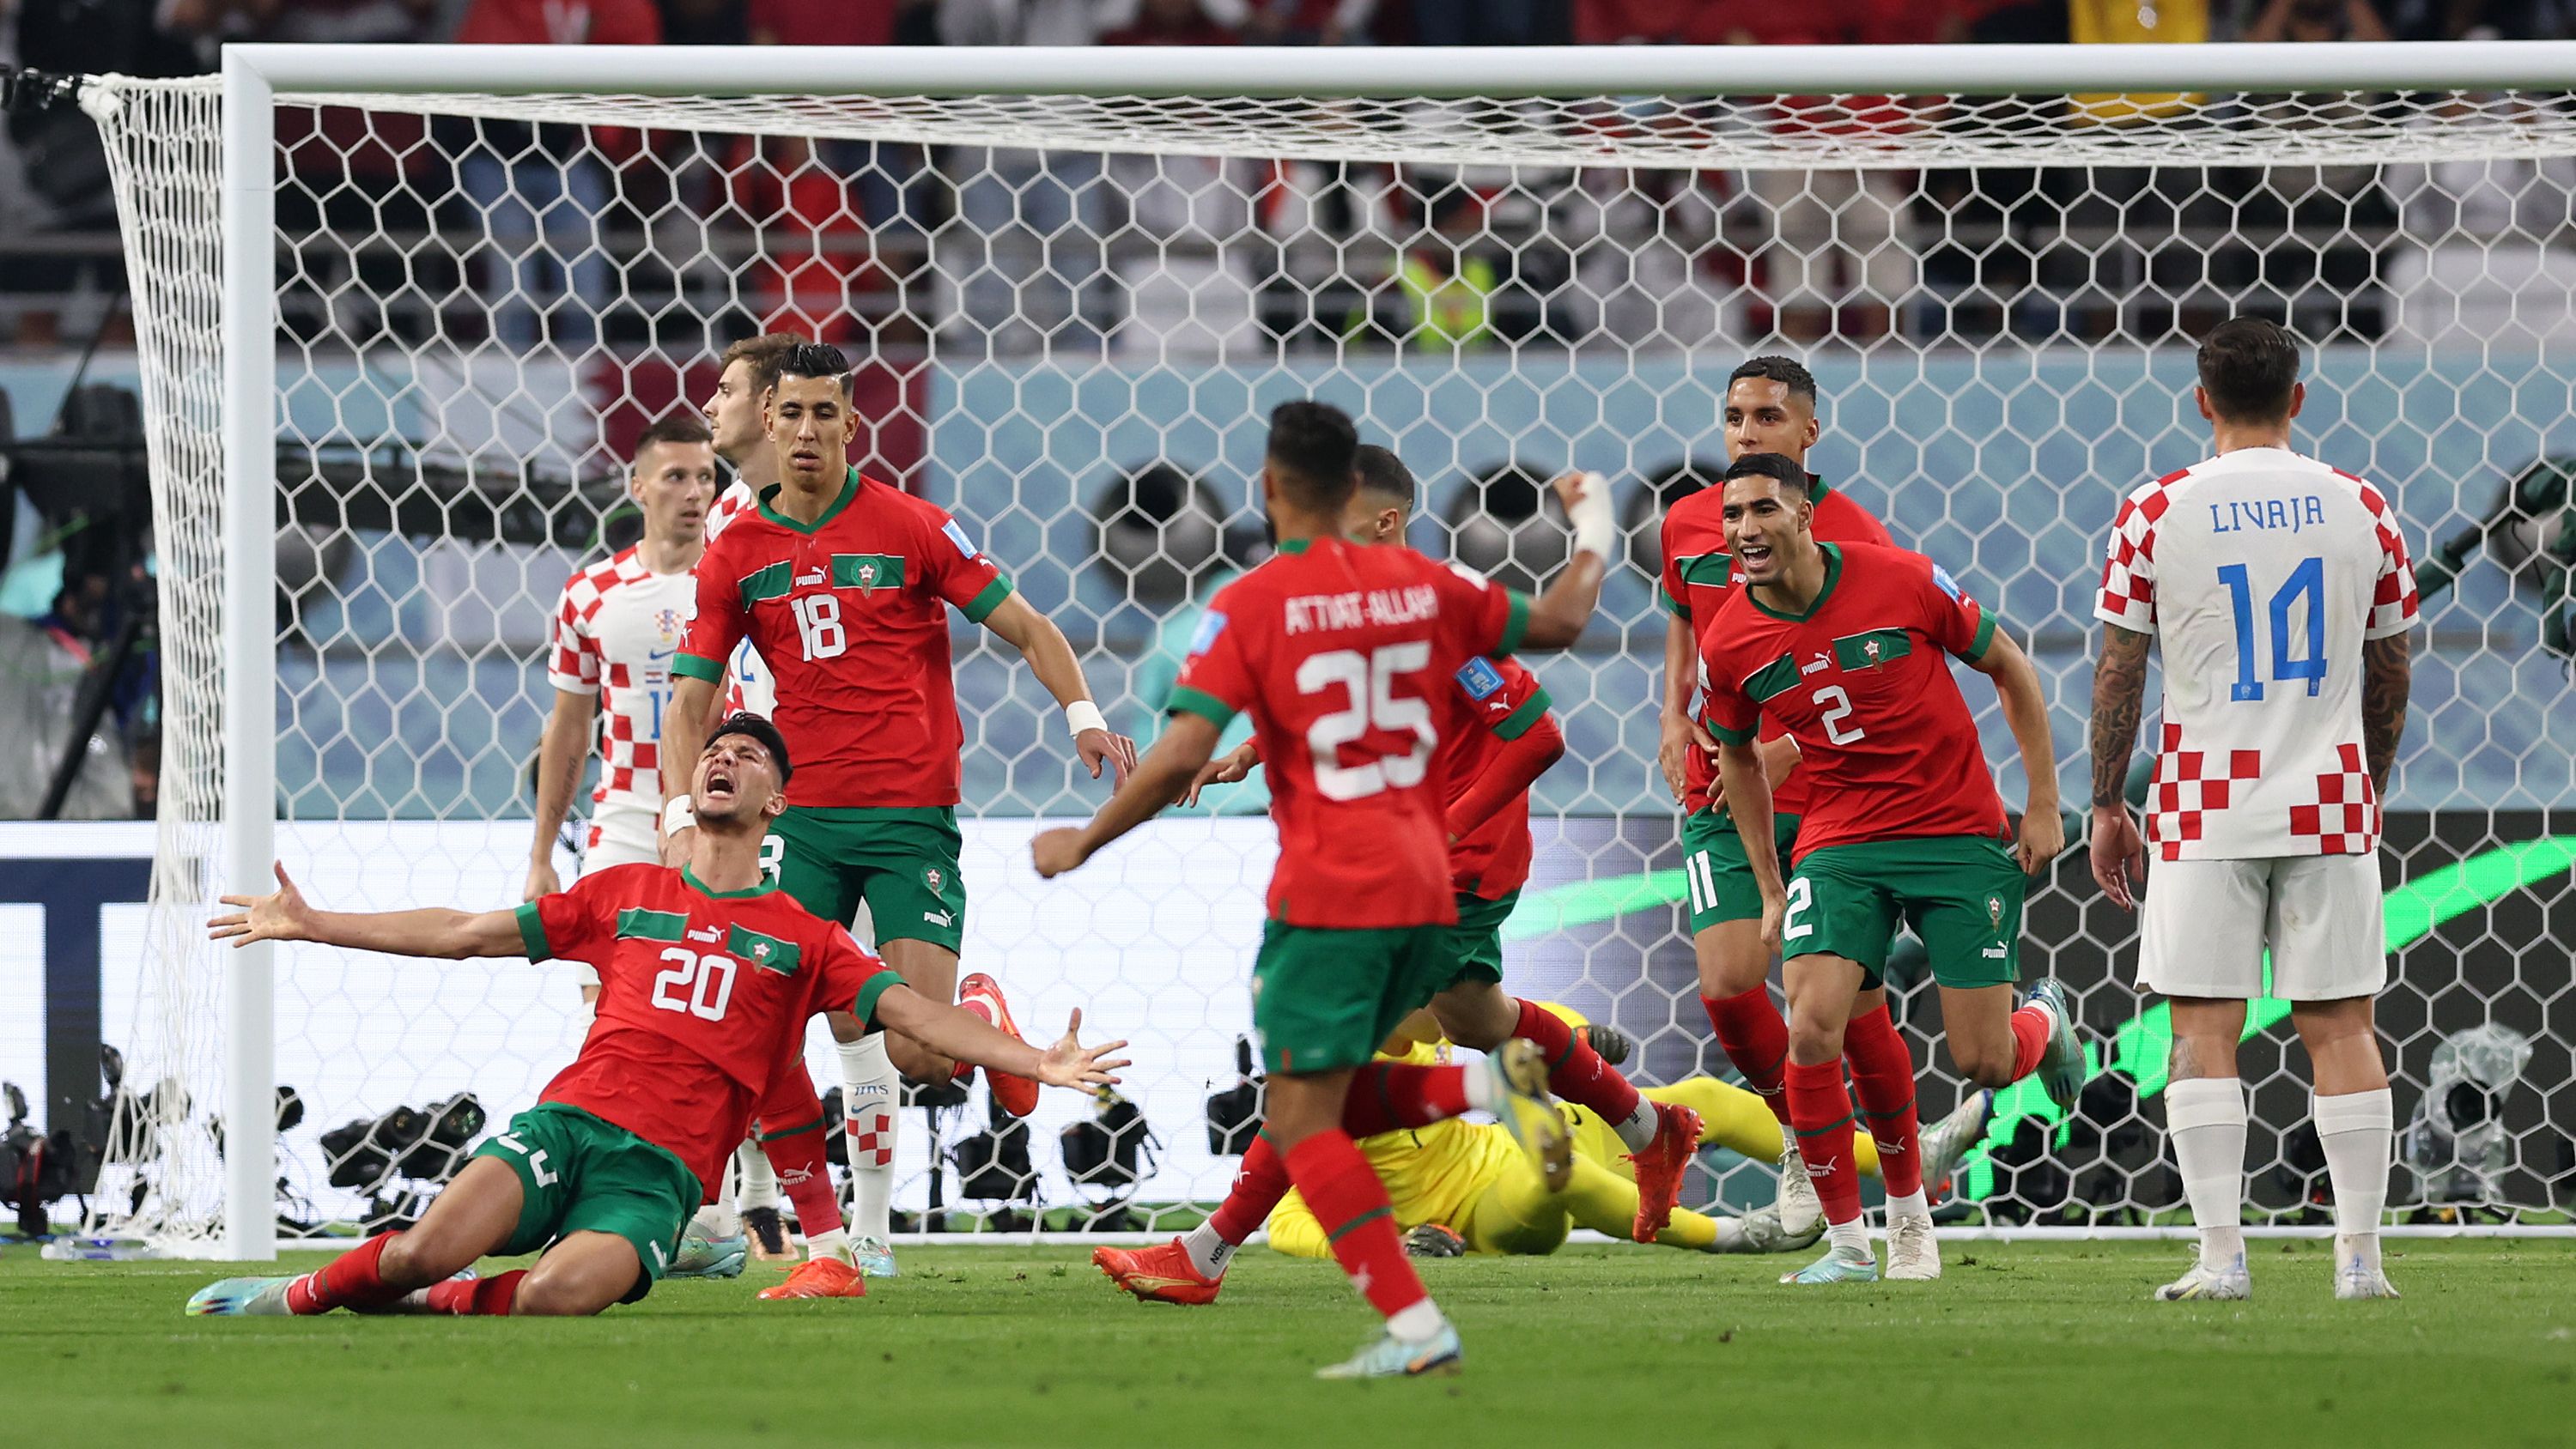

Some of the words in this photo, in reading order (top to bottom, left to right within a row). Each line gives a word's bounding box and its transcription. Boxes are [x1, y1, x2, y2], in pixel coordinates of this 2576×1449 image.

[2209, 495, 2325, 534] LIVAJA
[795, 574, 823, 586] PUMA
[790, 593, 847, 662] 18
[2216, 556, 2328, 702] 14
[1801, 659, 1829, 676] PUMA
[649, 690, 673, 740] 1
[1296, 640, 1439, 802] 25
[1812, 684, 1866, 746] 2
[1686, 849, 1718, 916] 11
[1783, 876, 1813, 942] 2
[687, 929, 717, 943] PUMA
[924, 912, 948, 927] PUMA
[651, 947, 738, 1022] 20
